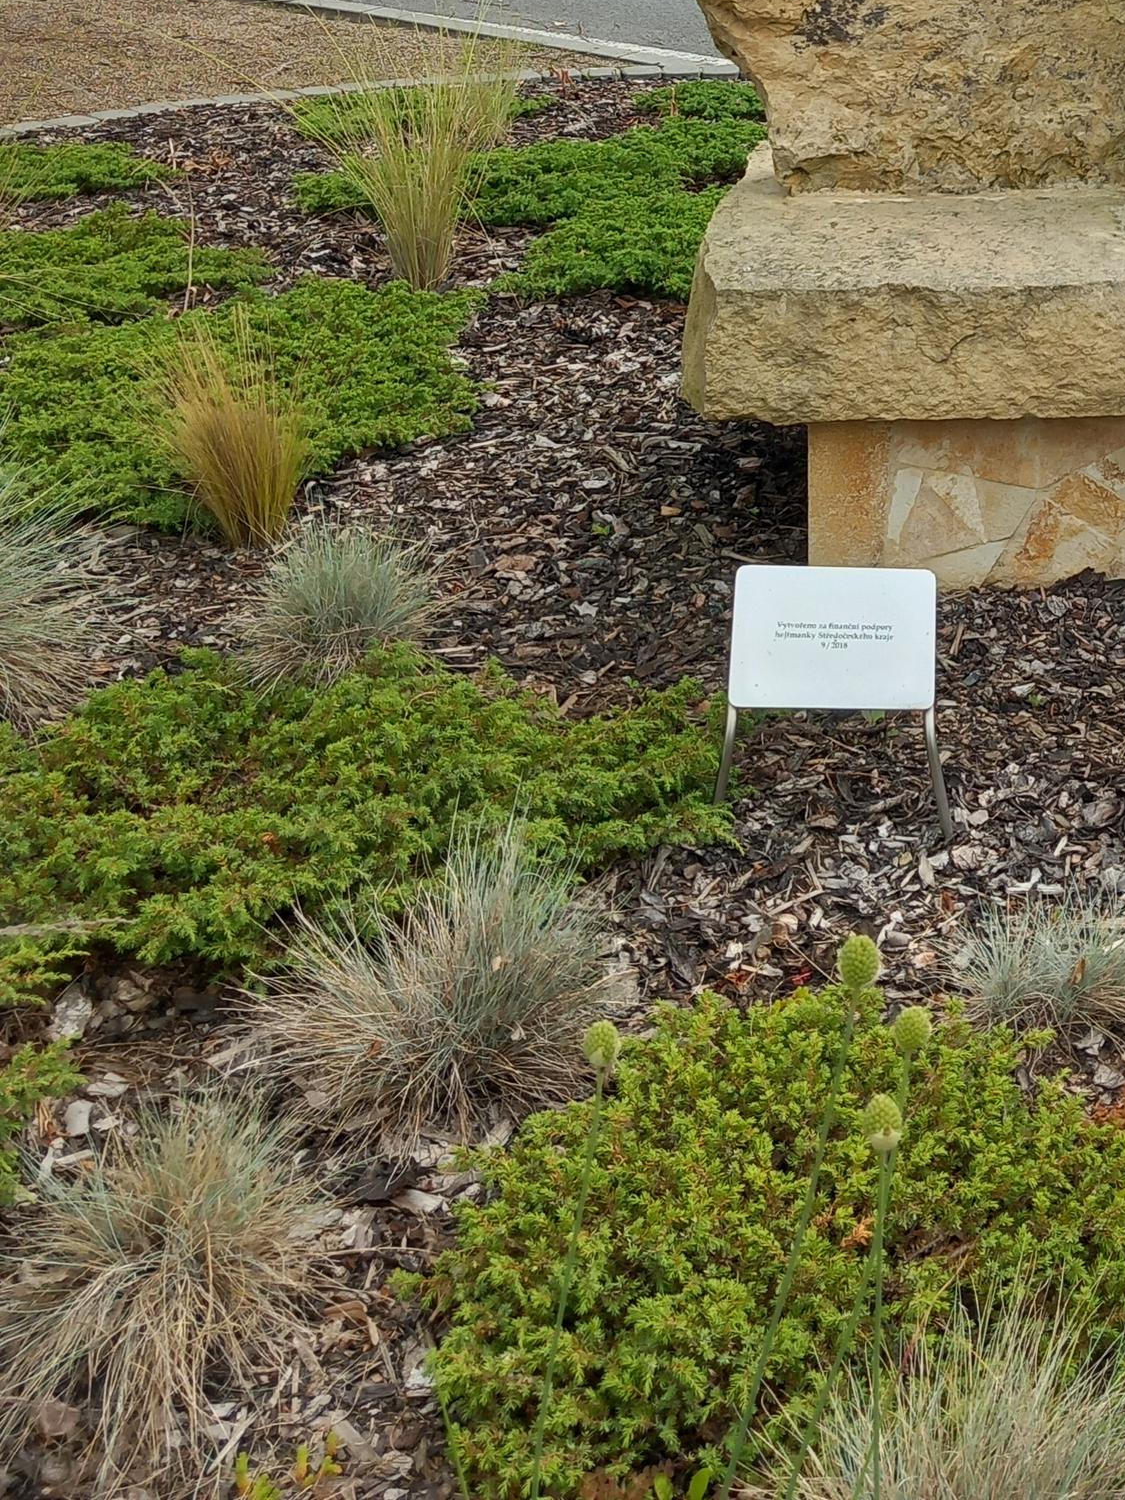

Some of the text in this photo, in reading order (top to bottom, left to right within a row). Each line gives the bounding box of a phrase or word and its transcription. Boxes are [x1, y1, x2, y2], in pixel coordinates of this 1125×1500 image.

[777, 621, 817, 630] Vytvořeno
[828, 622, 860, 630] finanční
[775, 631, 816, 639] hejtmanky
[875, 633, 894, 642] kraje
